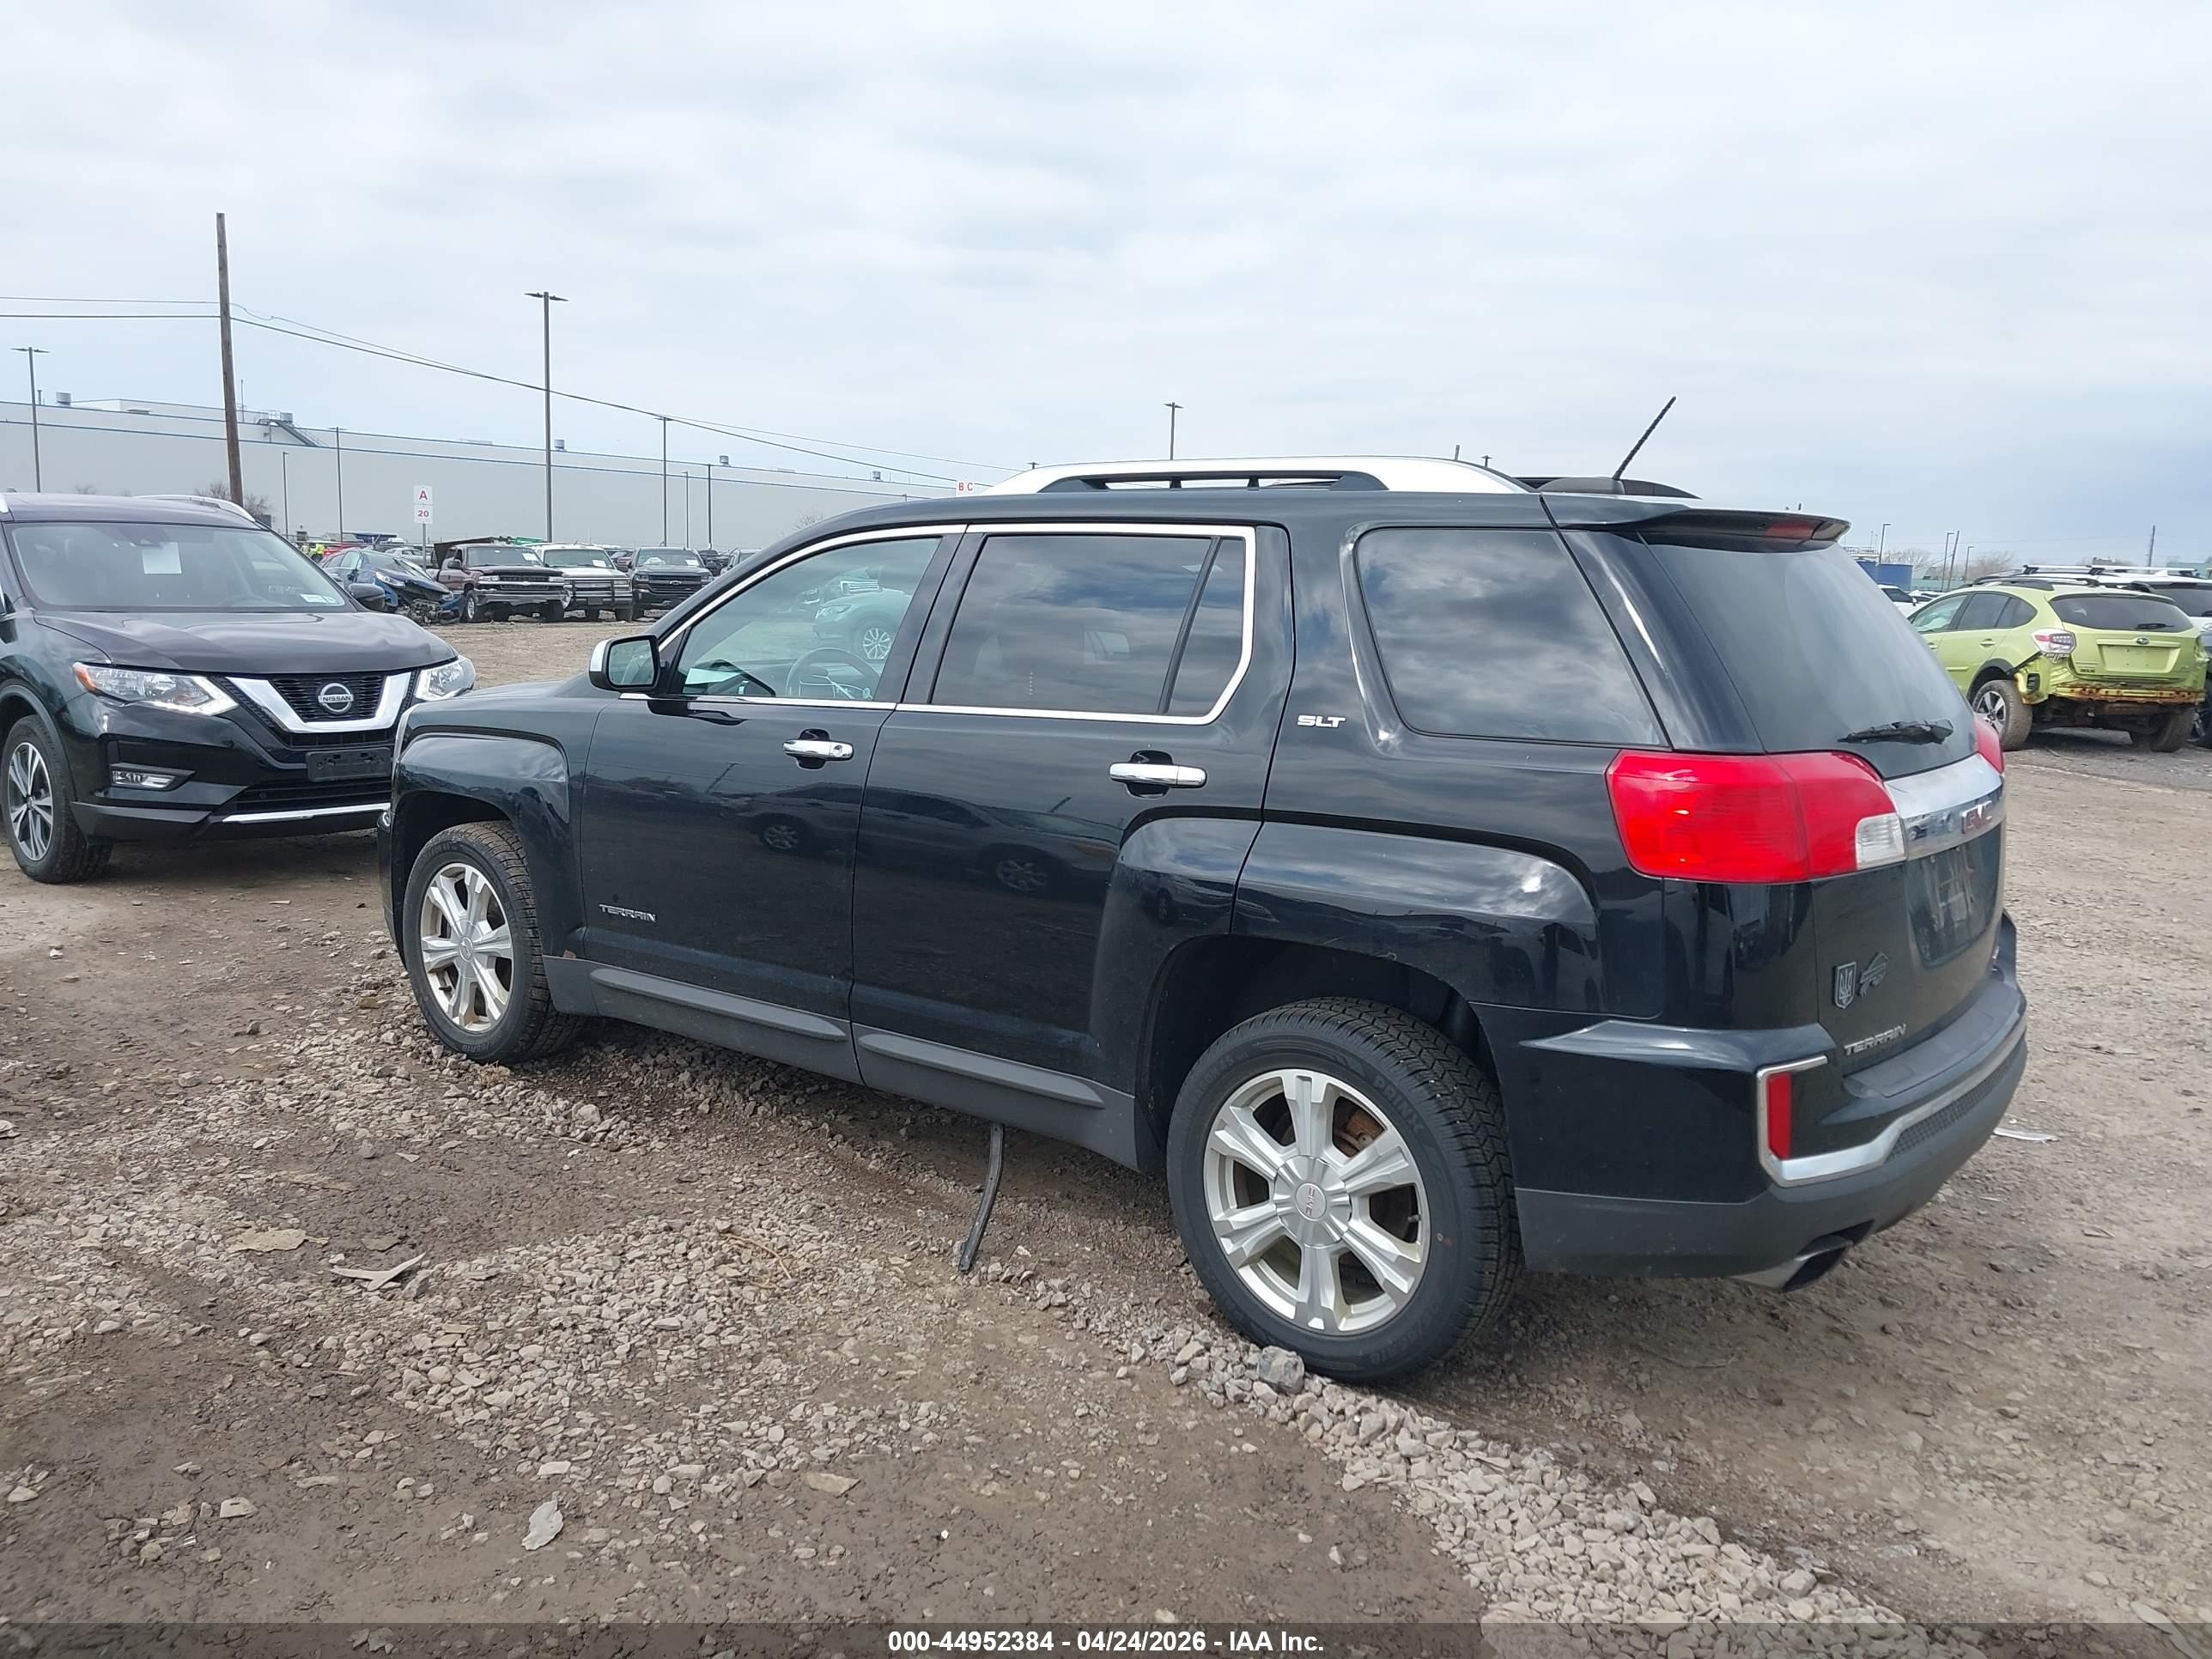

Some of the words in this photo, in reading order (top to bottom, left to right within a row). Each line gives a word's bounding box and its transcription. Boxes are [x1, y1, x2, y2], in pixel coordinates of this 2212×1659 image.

[958, 482, 964, 491] B
[967, 482, 974, 491] C
[418, 489, 428, 501] A
[417, 509, 429, 518] 20
[1297, 714, 1346, 728] SLT
[599, 903, 657, 922] TERRAIN
[1844, 1023, 1906, 1056] TERRAIN
